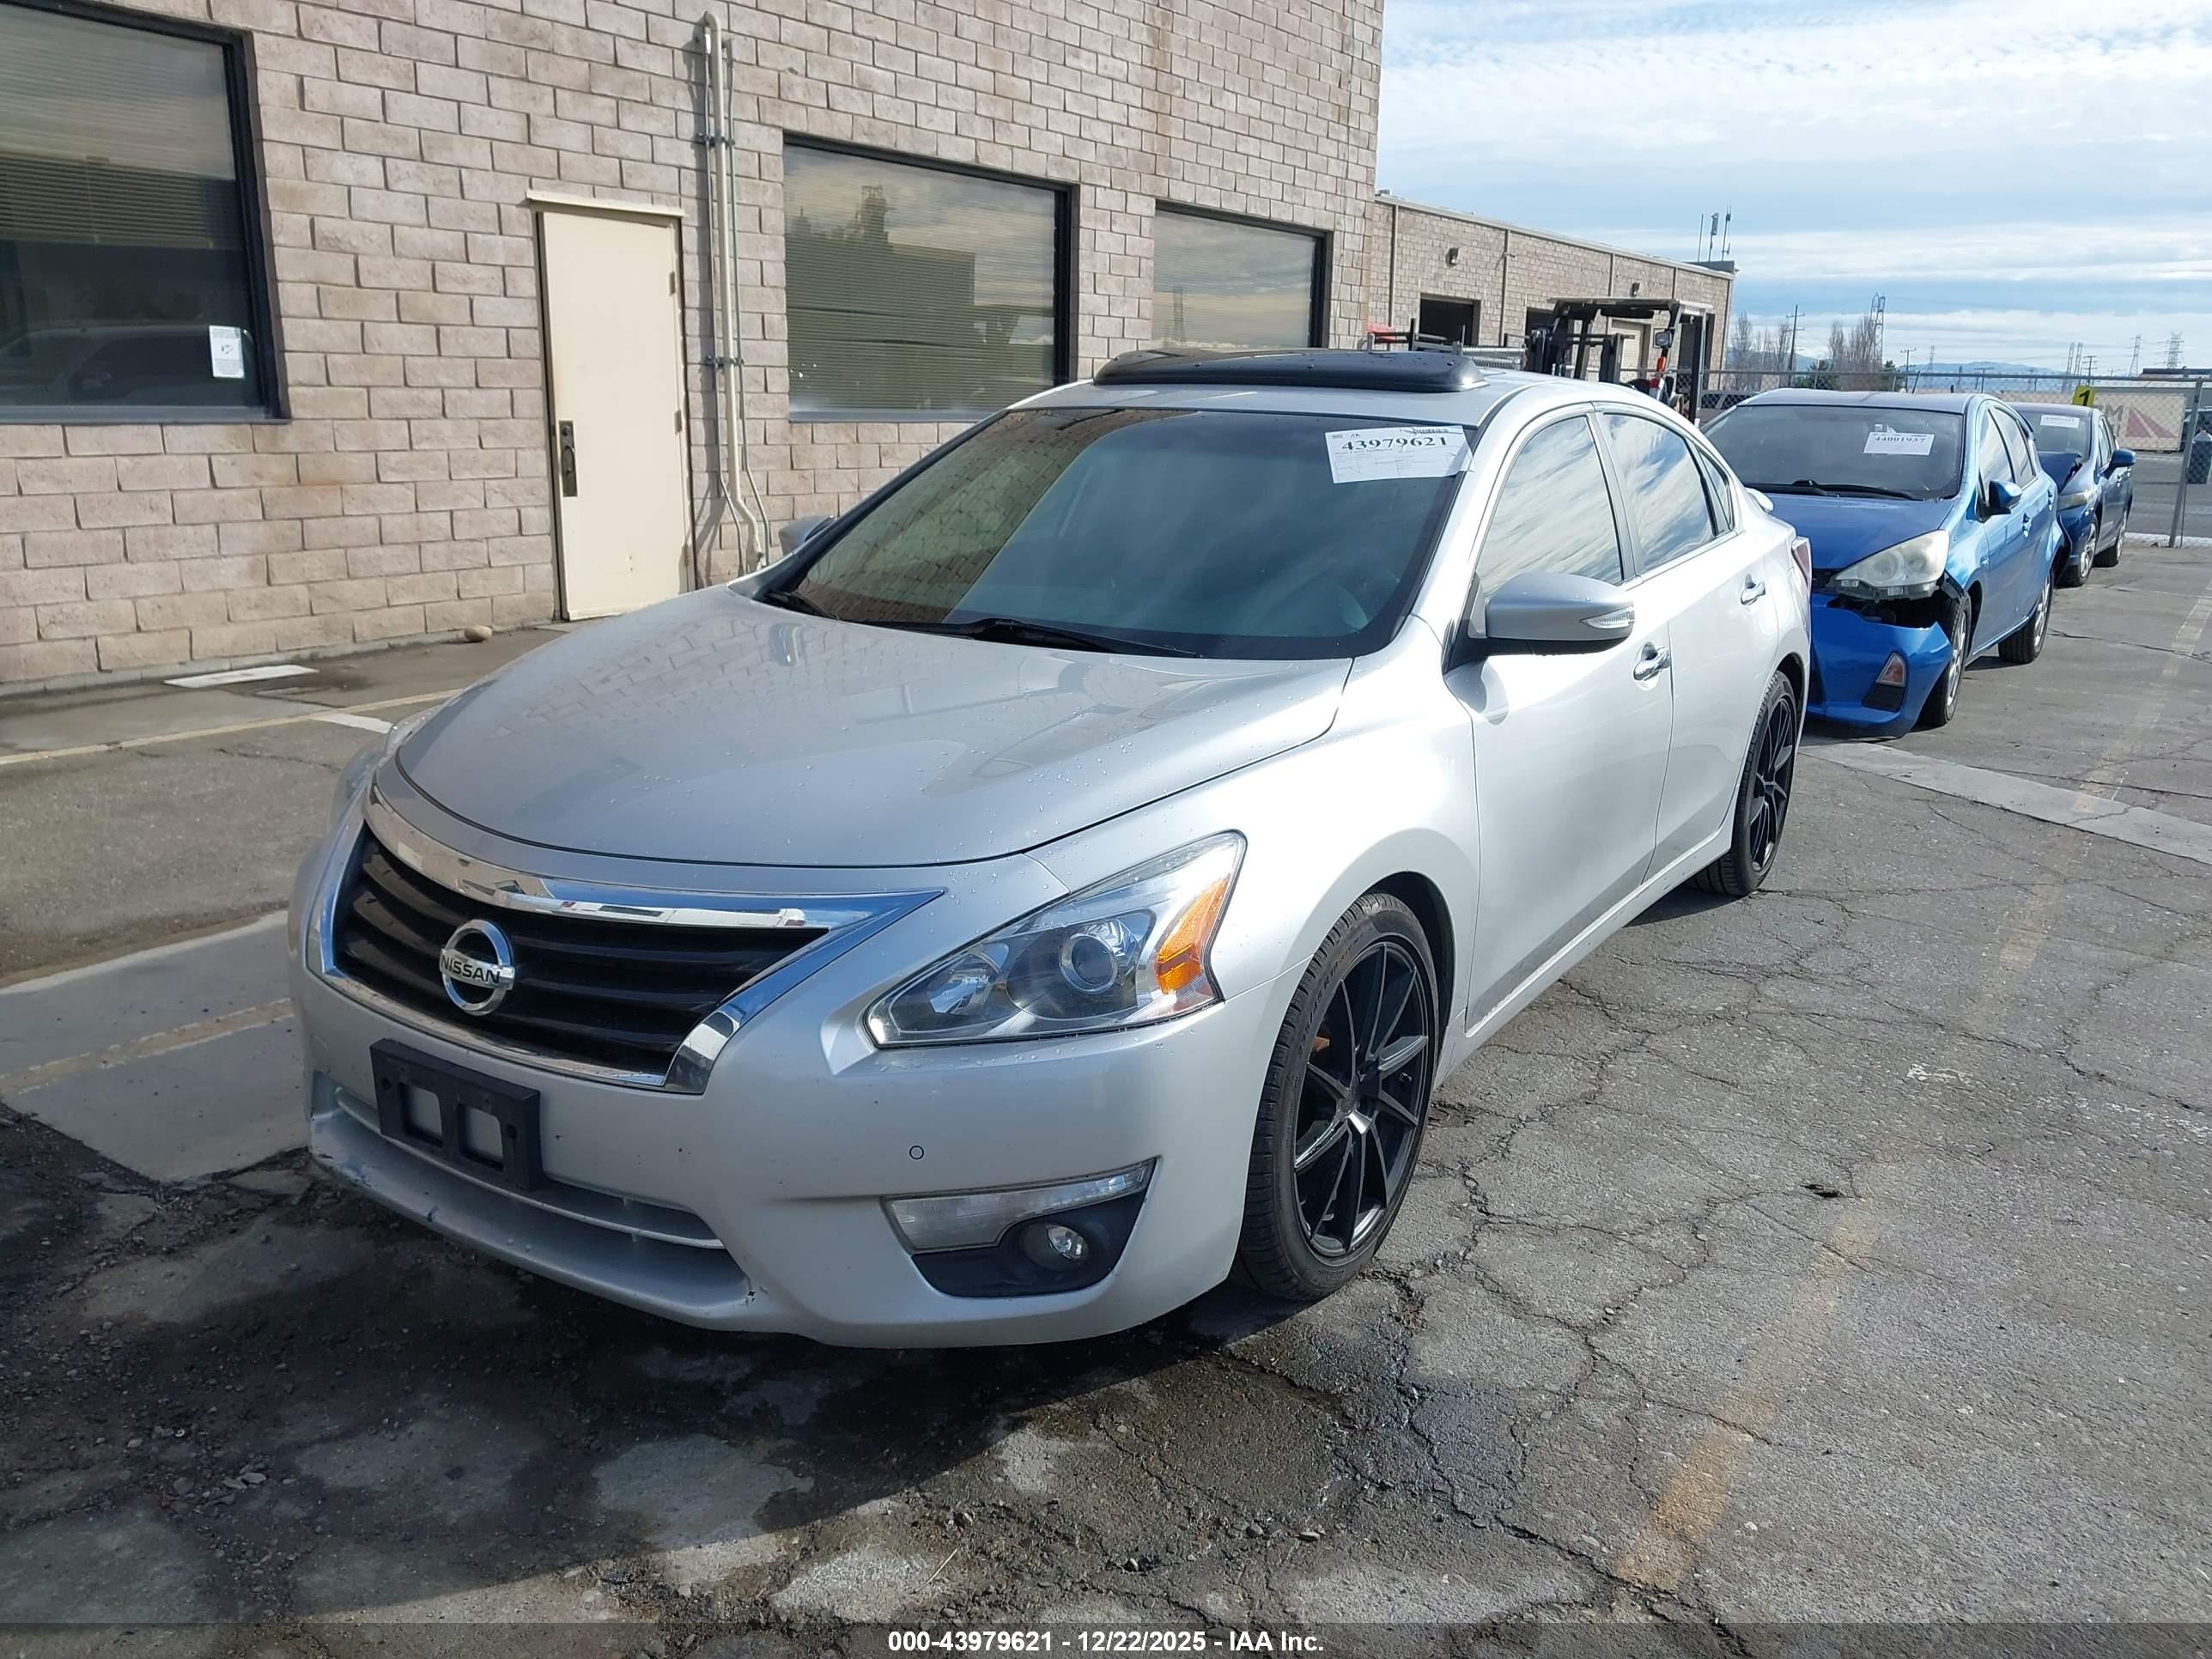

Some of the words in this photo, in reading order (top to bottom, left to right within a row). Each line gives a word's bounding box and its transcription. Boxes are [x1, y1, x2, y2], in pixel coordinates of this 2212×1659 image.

[2079, 389, 2090, 406] 1
[1341, 435, 1447, 451] 43979621
[441, 954, 501, 984] NISSAN
